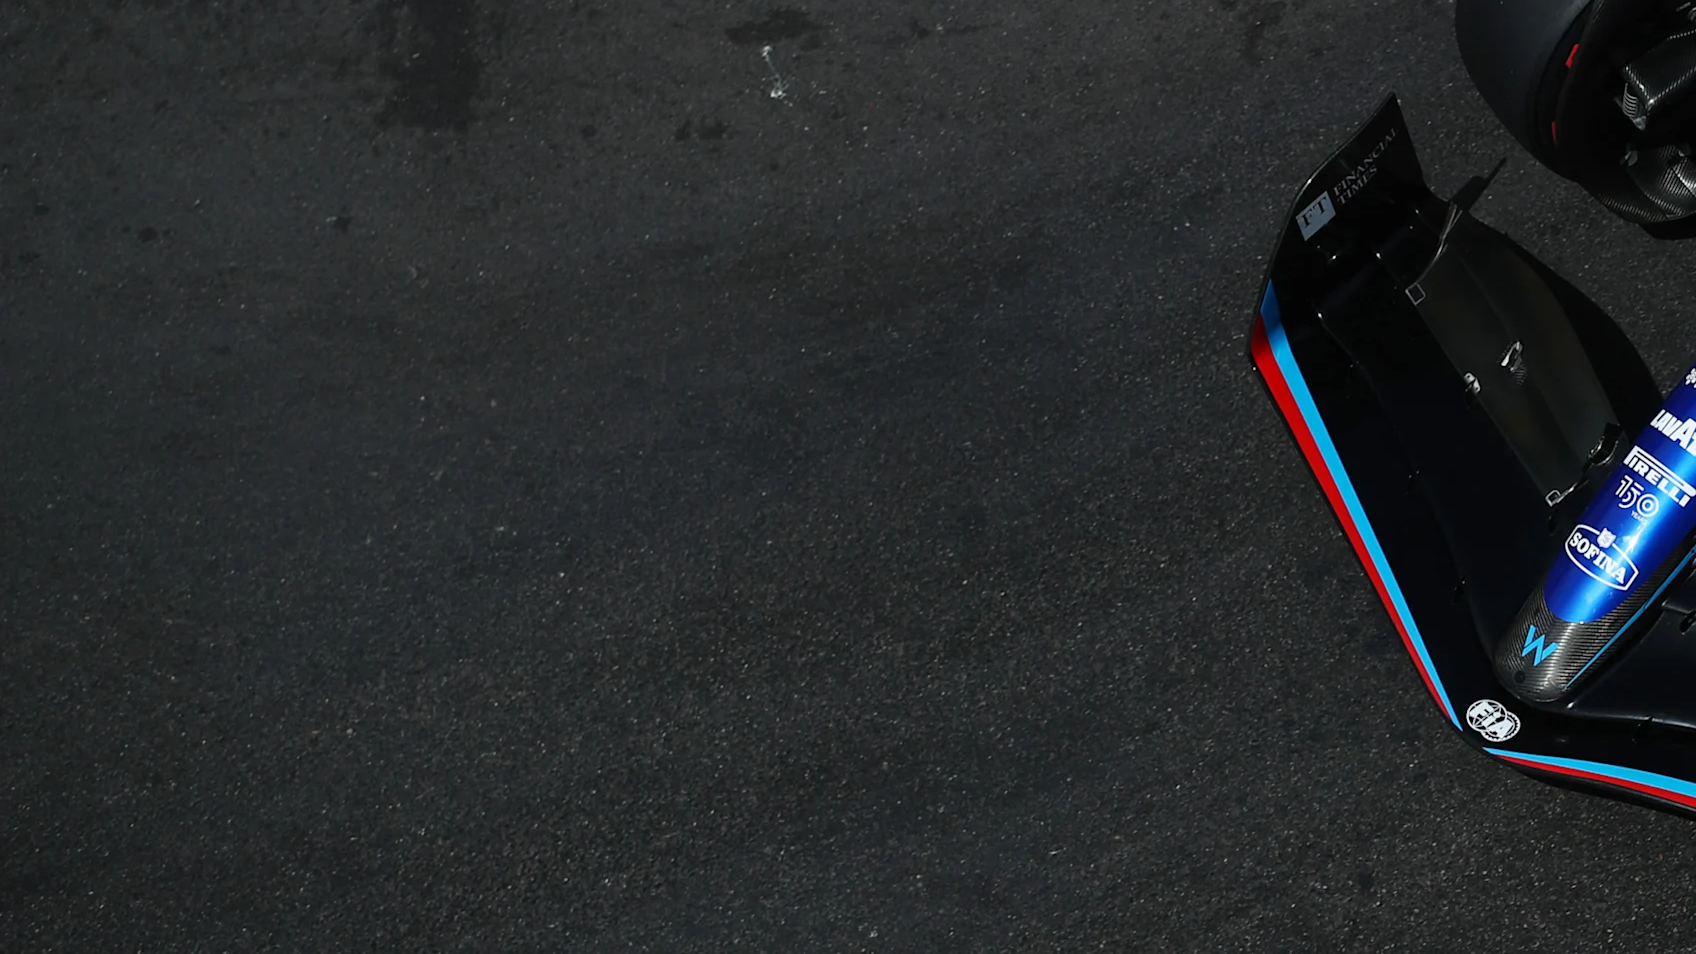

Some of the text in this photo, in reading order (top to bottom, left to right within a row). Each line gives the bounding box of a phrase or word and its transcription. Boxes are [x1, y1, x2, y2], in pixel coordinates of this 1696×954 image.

[1333, 127, 1399, 196] FINANCIAL
[1336, 166, 1378, 205] TIMES
[1301, 196, 1328, 229] FT
[1614, 475, 1660, 519] 150
[1569, 532, 1627, 585] SOFINA
[1522, 625, 1559, 667] W
